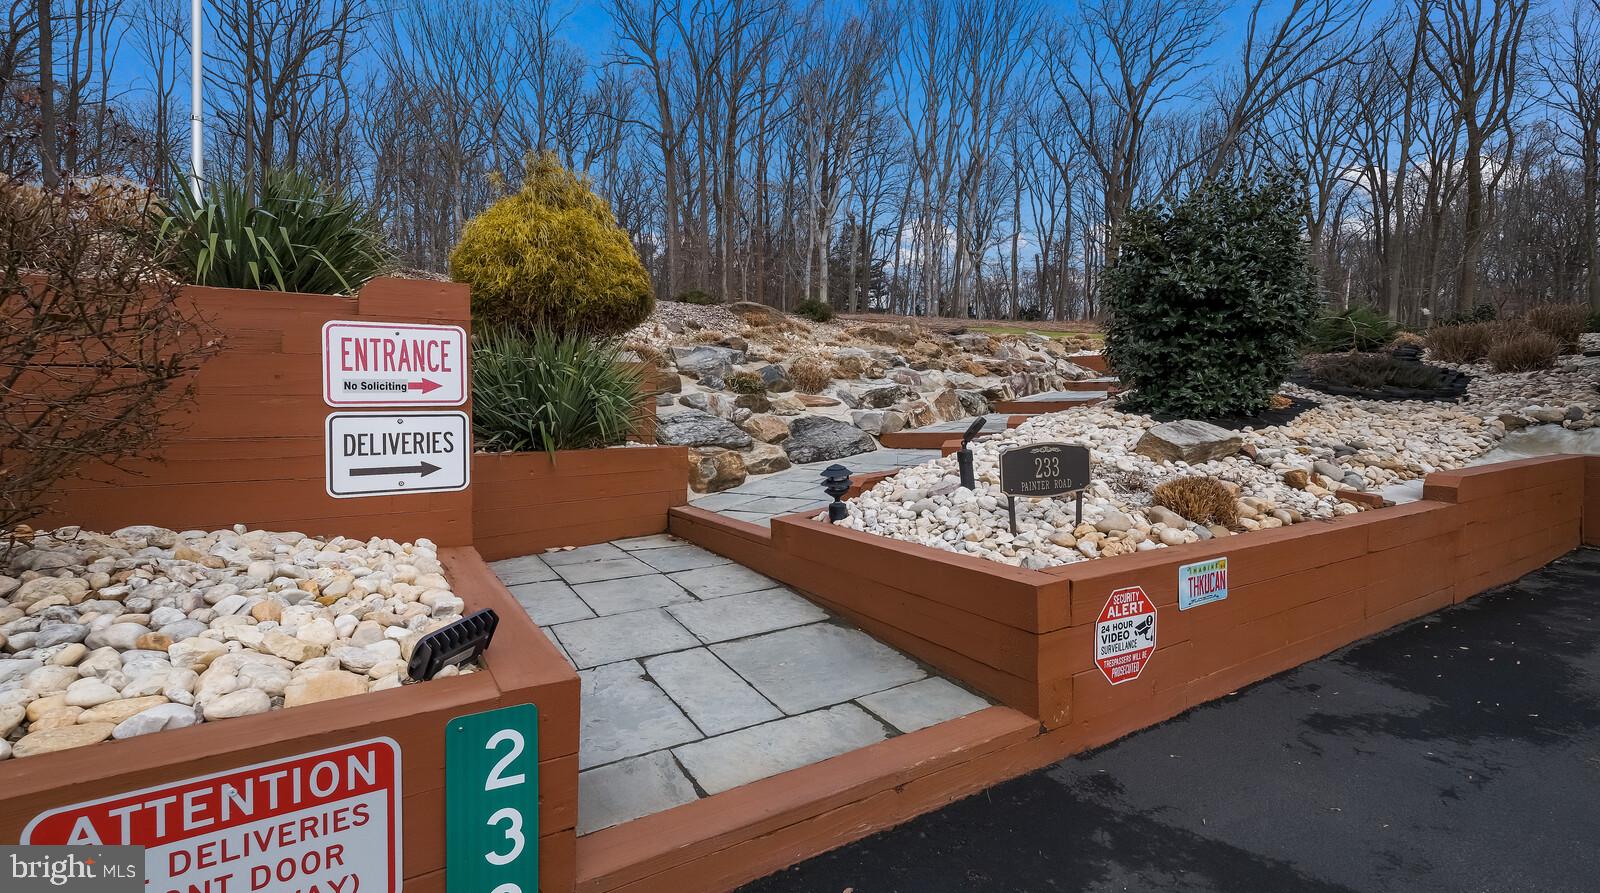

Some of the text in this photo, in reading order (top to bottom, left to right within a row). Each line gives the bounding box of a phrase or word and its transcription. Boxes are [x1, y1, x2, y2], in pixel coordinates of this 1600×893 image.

[341, 337, 451, 372] ENTRANCE
[343, 381, 407, 392] No Soliciting
[343, 431, 454, 456] DELIVERIES
[1034, 457, 1060, 478] 233
[1021, 479, 1072, 492] PAINTER ROAD
[1188, 570, 1225, 598] THKUCAN
[1113, 591, 1139, 605] SECURITY
[1107, 601, 1144, 618] ALERT
[1101, 620, 1133, 633] 24 HOUR
[1101, 630, 1130, 644] VIDEO
[1100, 639, 1138, 655] SURVEILLANCE
[66, 750, 376, 845] ATTENTION
[169, 803, 370, 877] DELIVERIES
[251, 844, 344, 891] DOOR
